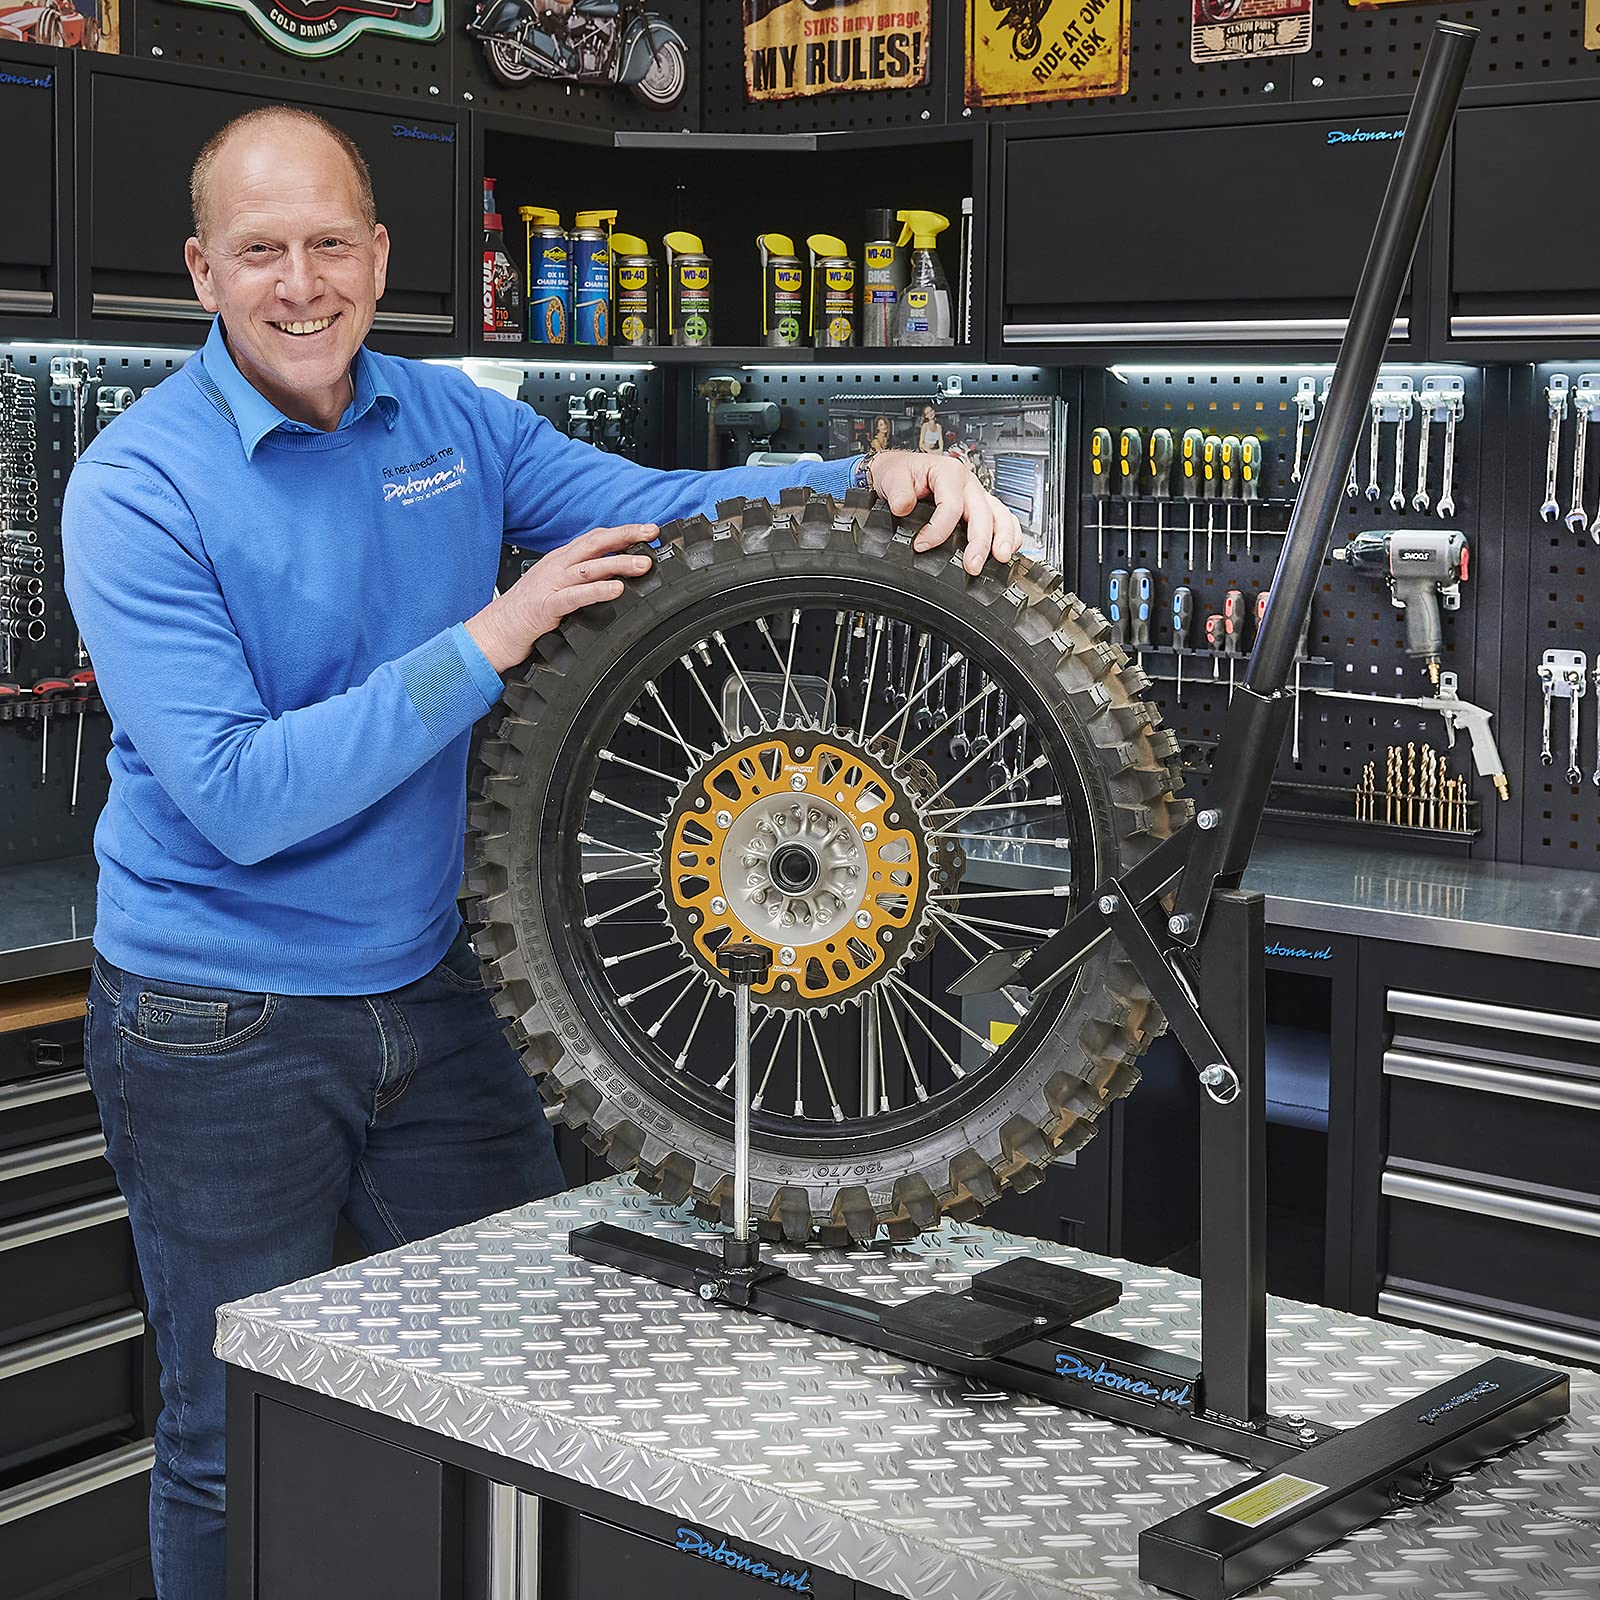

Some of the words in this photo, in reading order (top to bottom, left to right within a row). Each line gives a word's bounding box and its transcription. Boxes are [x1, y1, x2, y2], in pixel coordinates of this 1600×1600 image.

[269, 8, 297, 33] COLD
[300, 18, 338, 37] DRINKS
[804, 17, 839, 37] STAYS
[843, 16, 855, 33] in
[855, 16, 874, 33] my
[877, 10, 922, 31] garage.
[1226, 21, 1254, 34] CUSTOM
[1254, 20, 1276, 31] PARTS
[1032, 42, 1067, 85] RIDE
[1062, 19, 1083, 49] AT
[1080, 0, 1110, 25] OW
[1068, 27, 1106, 72] RISK
[752, 45, 798, 91] MY
[806, 31, 922, 85] RULES!
[0, 73, 53, 88] ona.nl
[1327, 128, 1405, 144] Datona.n
[868, 248, 891, 259] WD-40
[621, 270, 645, 280] WD-40
[683, 270, 708, 280] WD-40
[868, 270, 891, 283] BIKE
[483, 260, 494, 326] MOTUL
[496, 310, 509, 320] 710
[382, 457, 467, 502] Datona.nl
[1264, 941, 1333, 959] atona.nl
[151, 1010, 173, 1024] 247
[593, 1064, 674, 1134] CROSS
[1055, 1353, 1192, 1405] Datona.nl
[675, 1527, 810, 1592] Datona.nl
